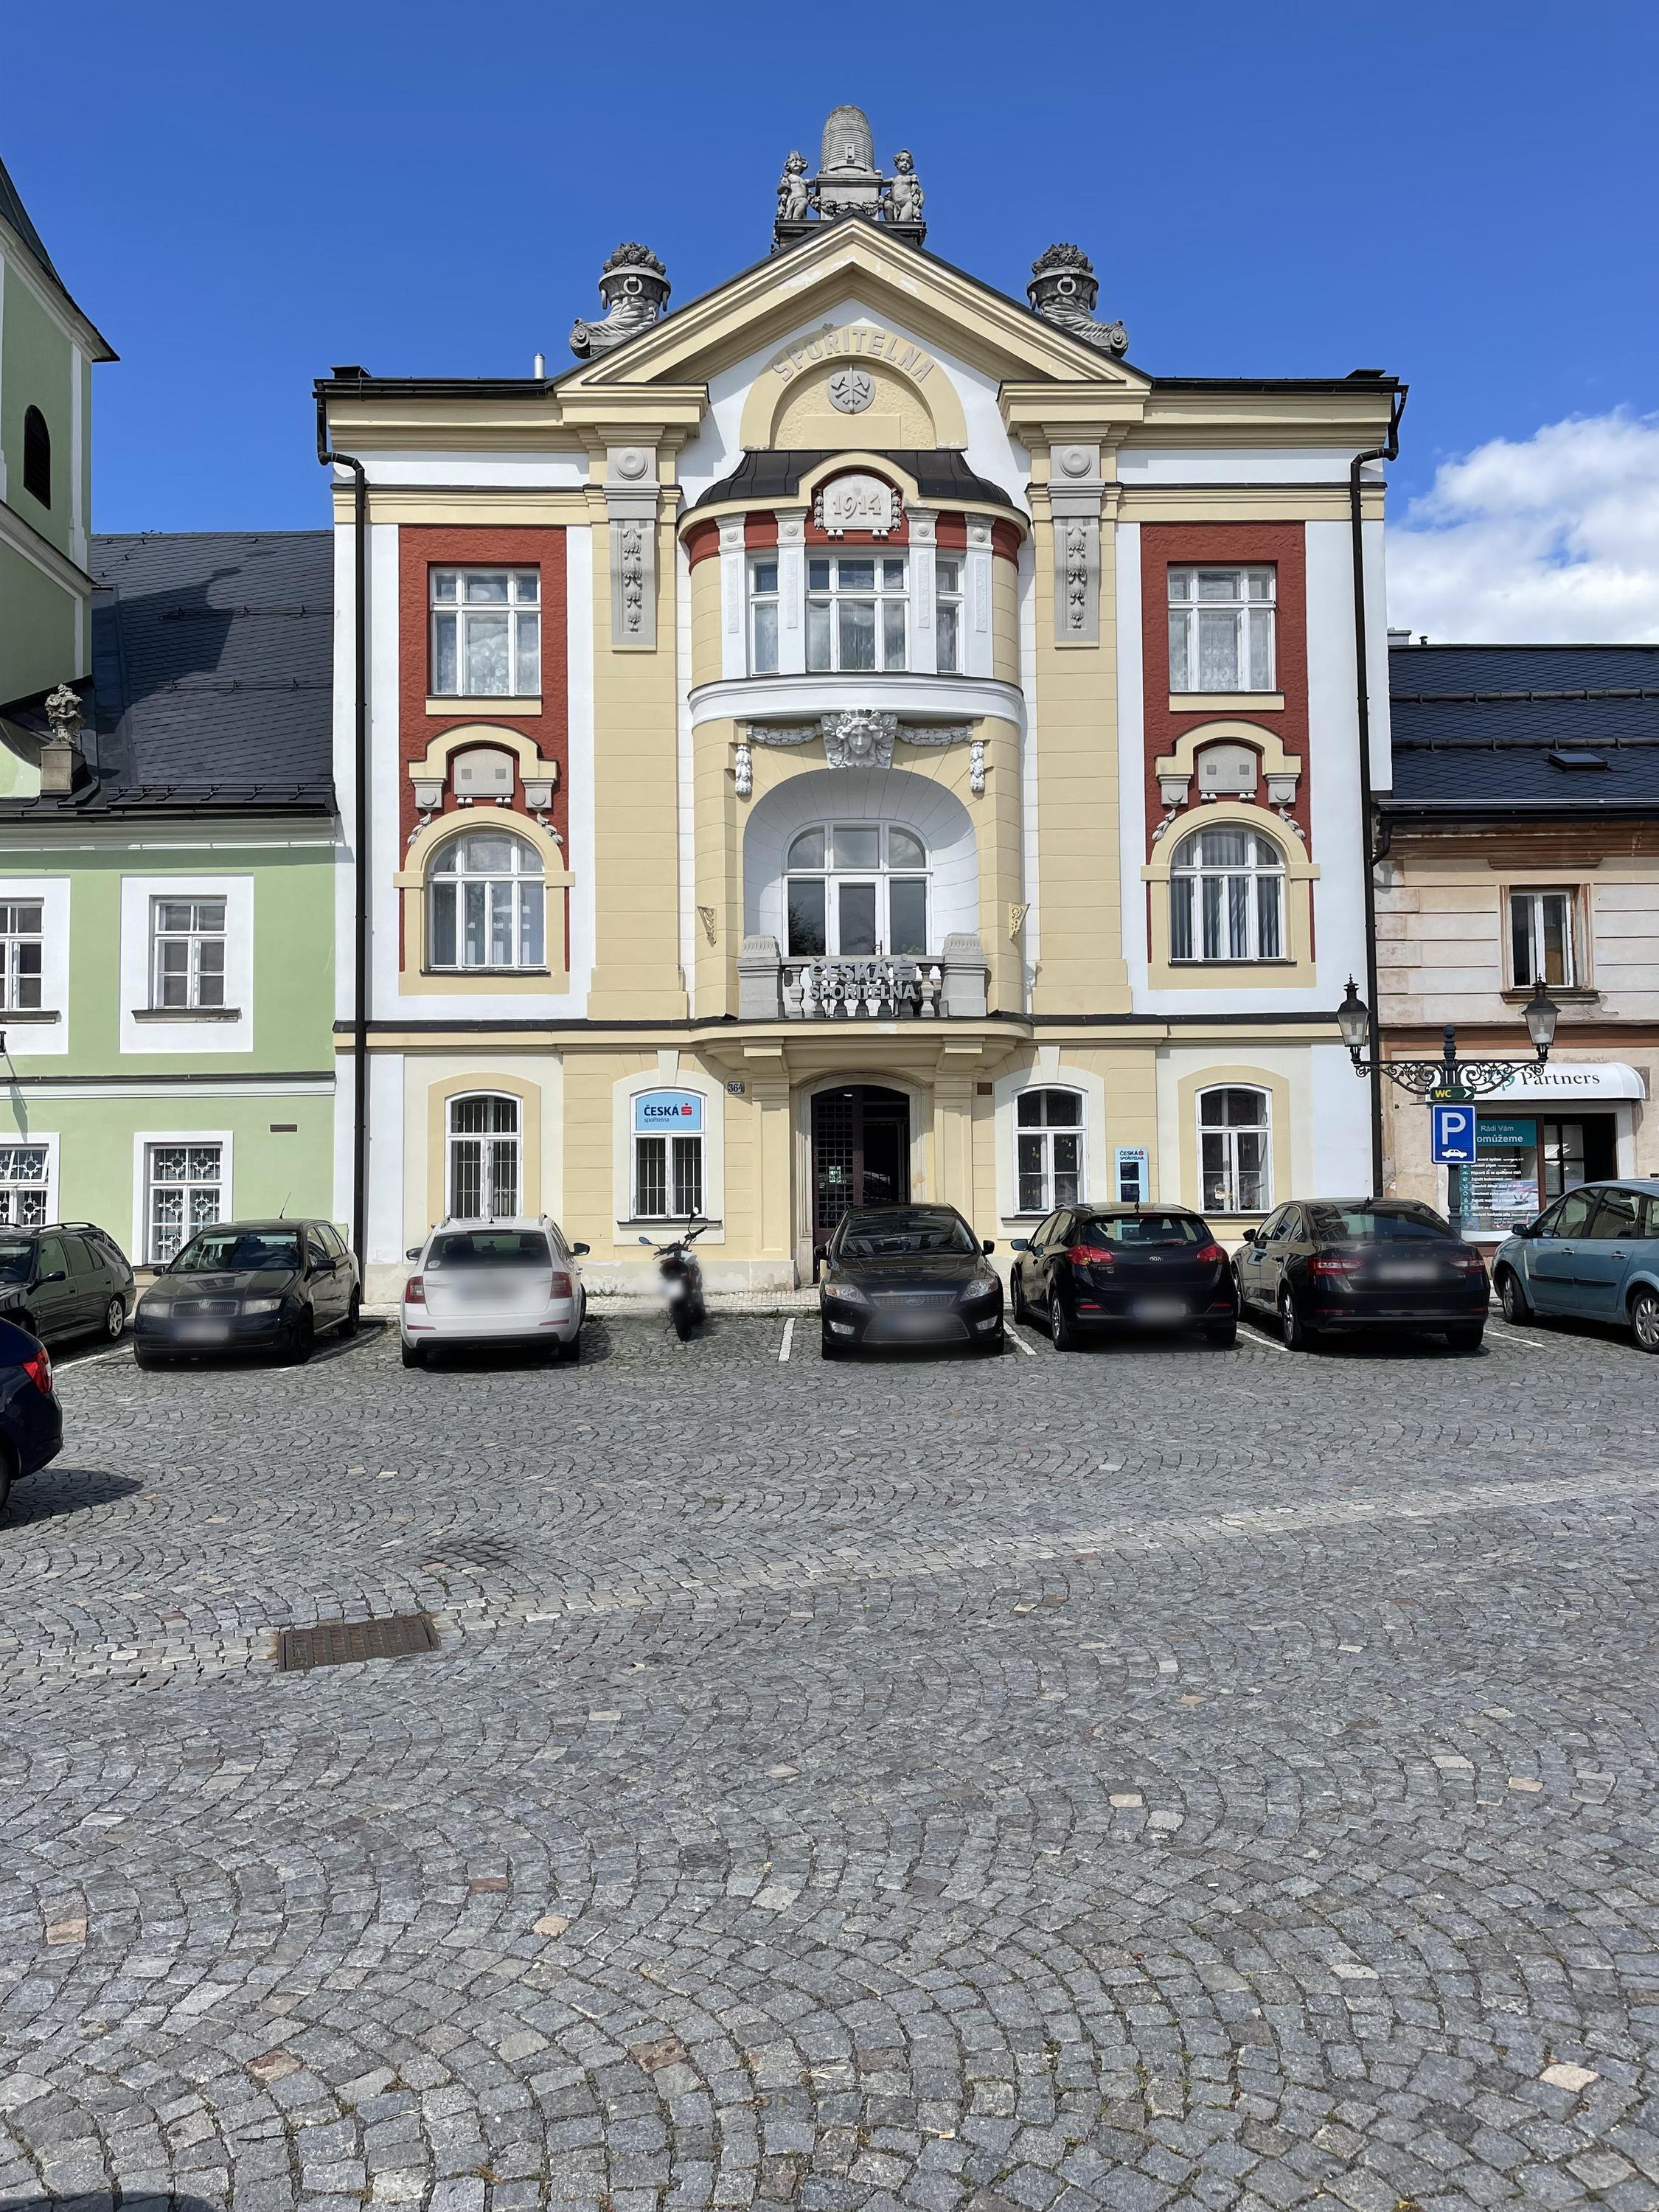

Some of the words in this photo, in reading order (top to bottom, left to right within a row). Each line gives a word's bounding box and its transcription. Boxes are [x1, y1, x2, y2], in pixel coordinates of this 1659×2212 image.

[773, 323, 935, 383] SPOŘITELNA
[833, 495, 882, 520] 1914
[808, 958, 891, 982] ČESKÁ
[810, 981, 917, 1001] SPOŘITELNA
[1520, 1071, 1600, 1085] Partners
[728, 1083, 744, 1093] 364
[1435, 1089, 1452, 1098] WC
[644, 1104, 679, 1116] ČESKÁ
[1441, 1112, 1466, 1145] P
[1476, 1134, 1523, 1143] omůžeme
